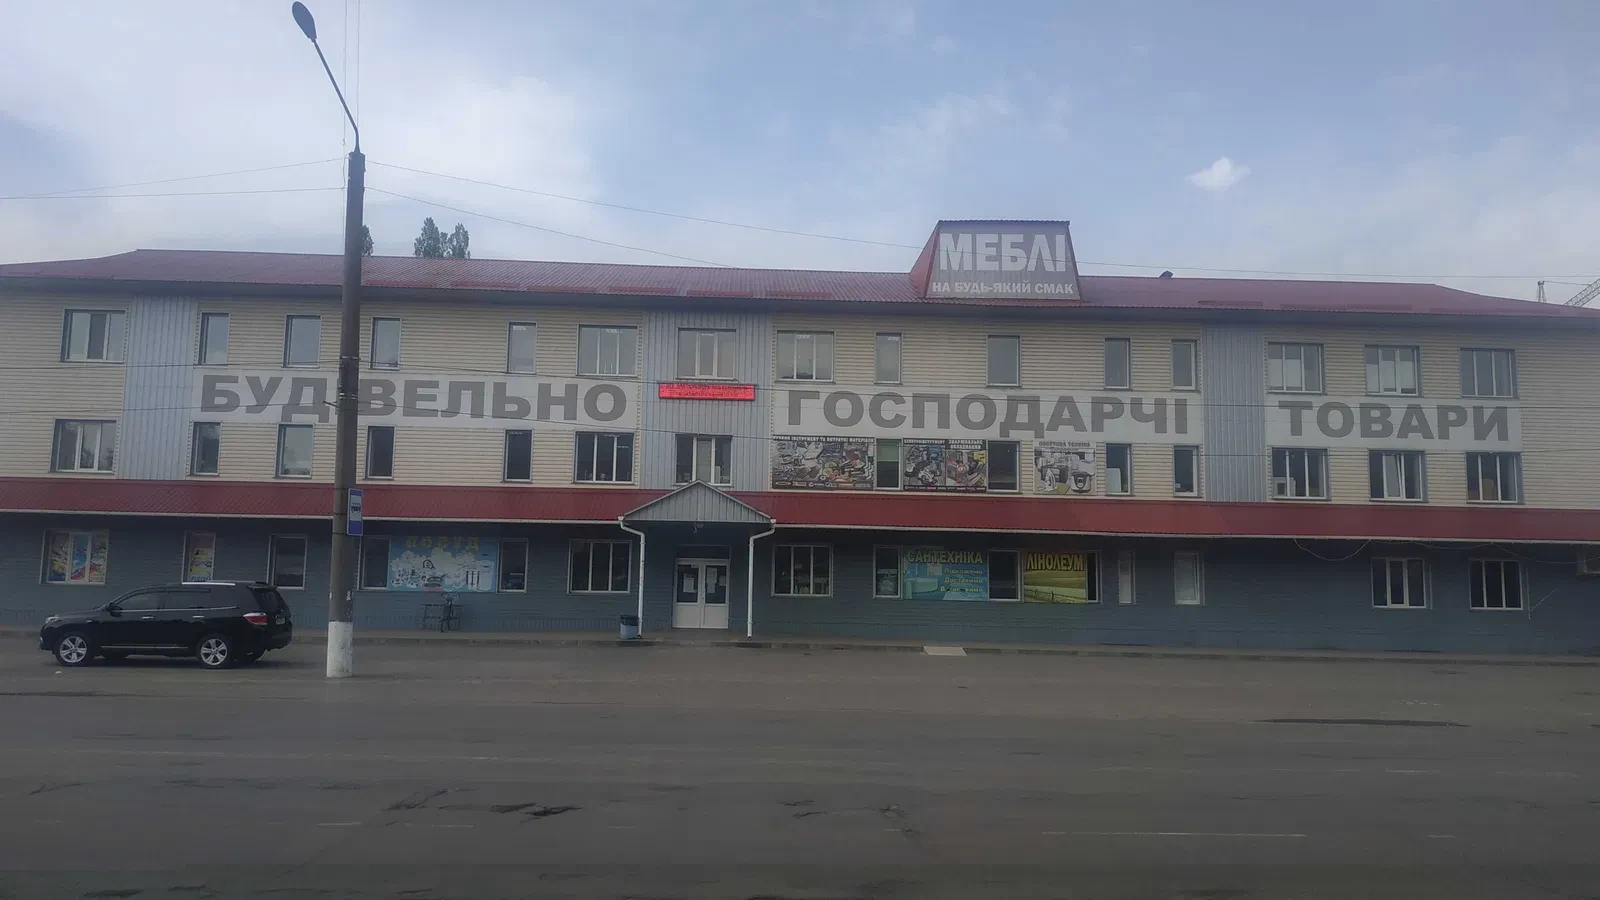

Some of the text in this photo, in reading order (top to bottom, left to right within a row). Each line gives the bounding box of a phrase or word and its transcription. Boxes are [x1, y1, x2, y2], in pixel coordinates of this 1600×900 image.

[939, 233, 1066, 272] МЕБЛІ
[932, 280, 1073, 295] НА БУДЬ-ЯКИЙ СМАК
[200, 374, 1509, 442] БУДВЕЛЬНО ГОСПОДАРЧІ ТОВАРИ
[907, 551, 984, 564] САНТЕХНІКА
[1026, 553, 1084, 571] ЛІНОЛЕУМ
